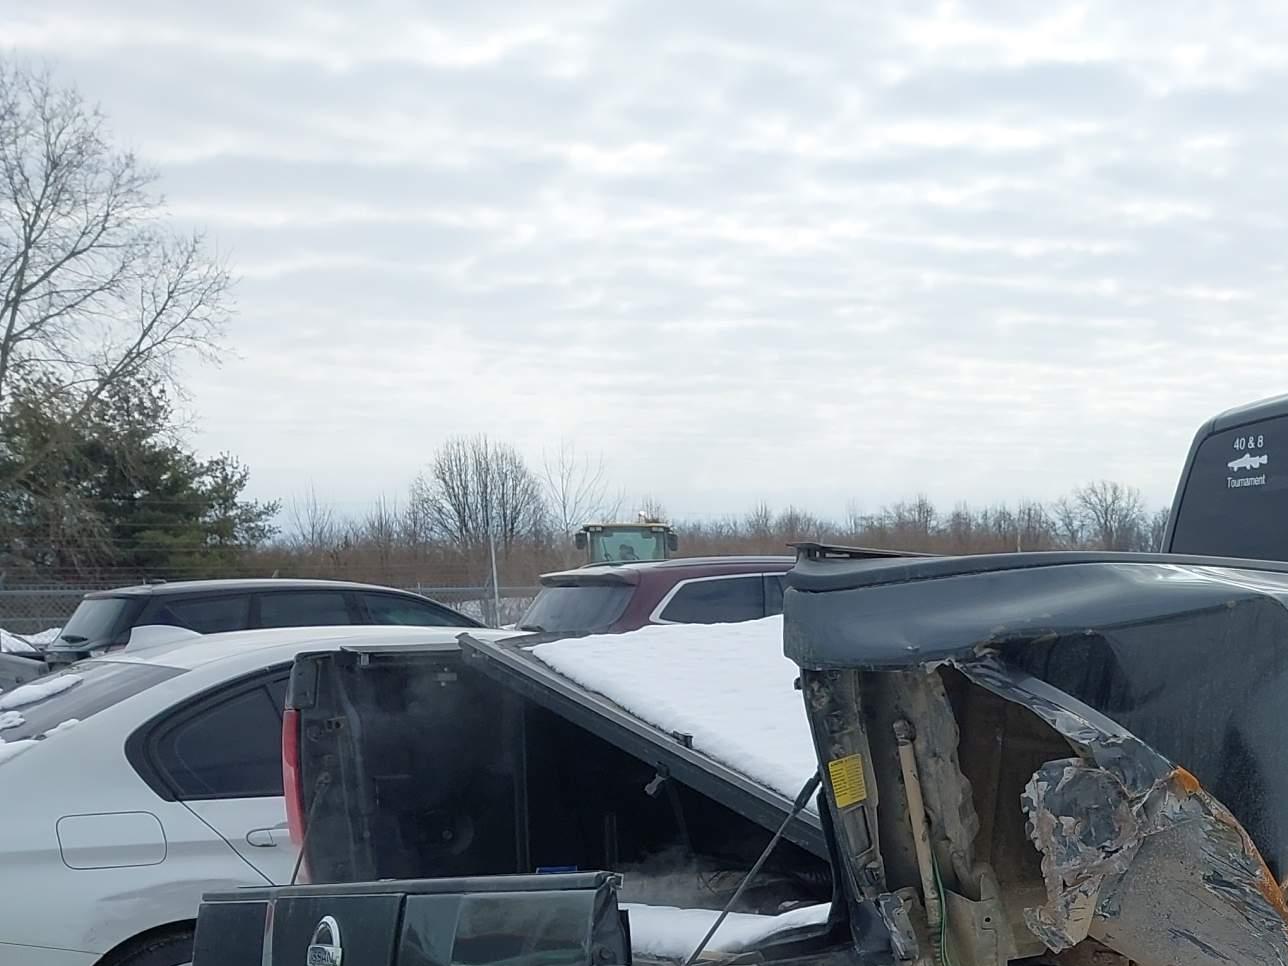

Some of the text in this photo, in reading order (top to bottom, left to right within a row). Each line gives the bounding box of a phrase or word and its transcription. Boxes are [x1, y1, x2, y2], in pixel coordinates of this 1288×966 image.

[1233, 435, 1264, 450] 40 & 8
[1226, 473, 1266, 489] Tournament
